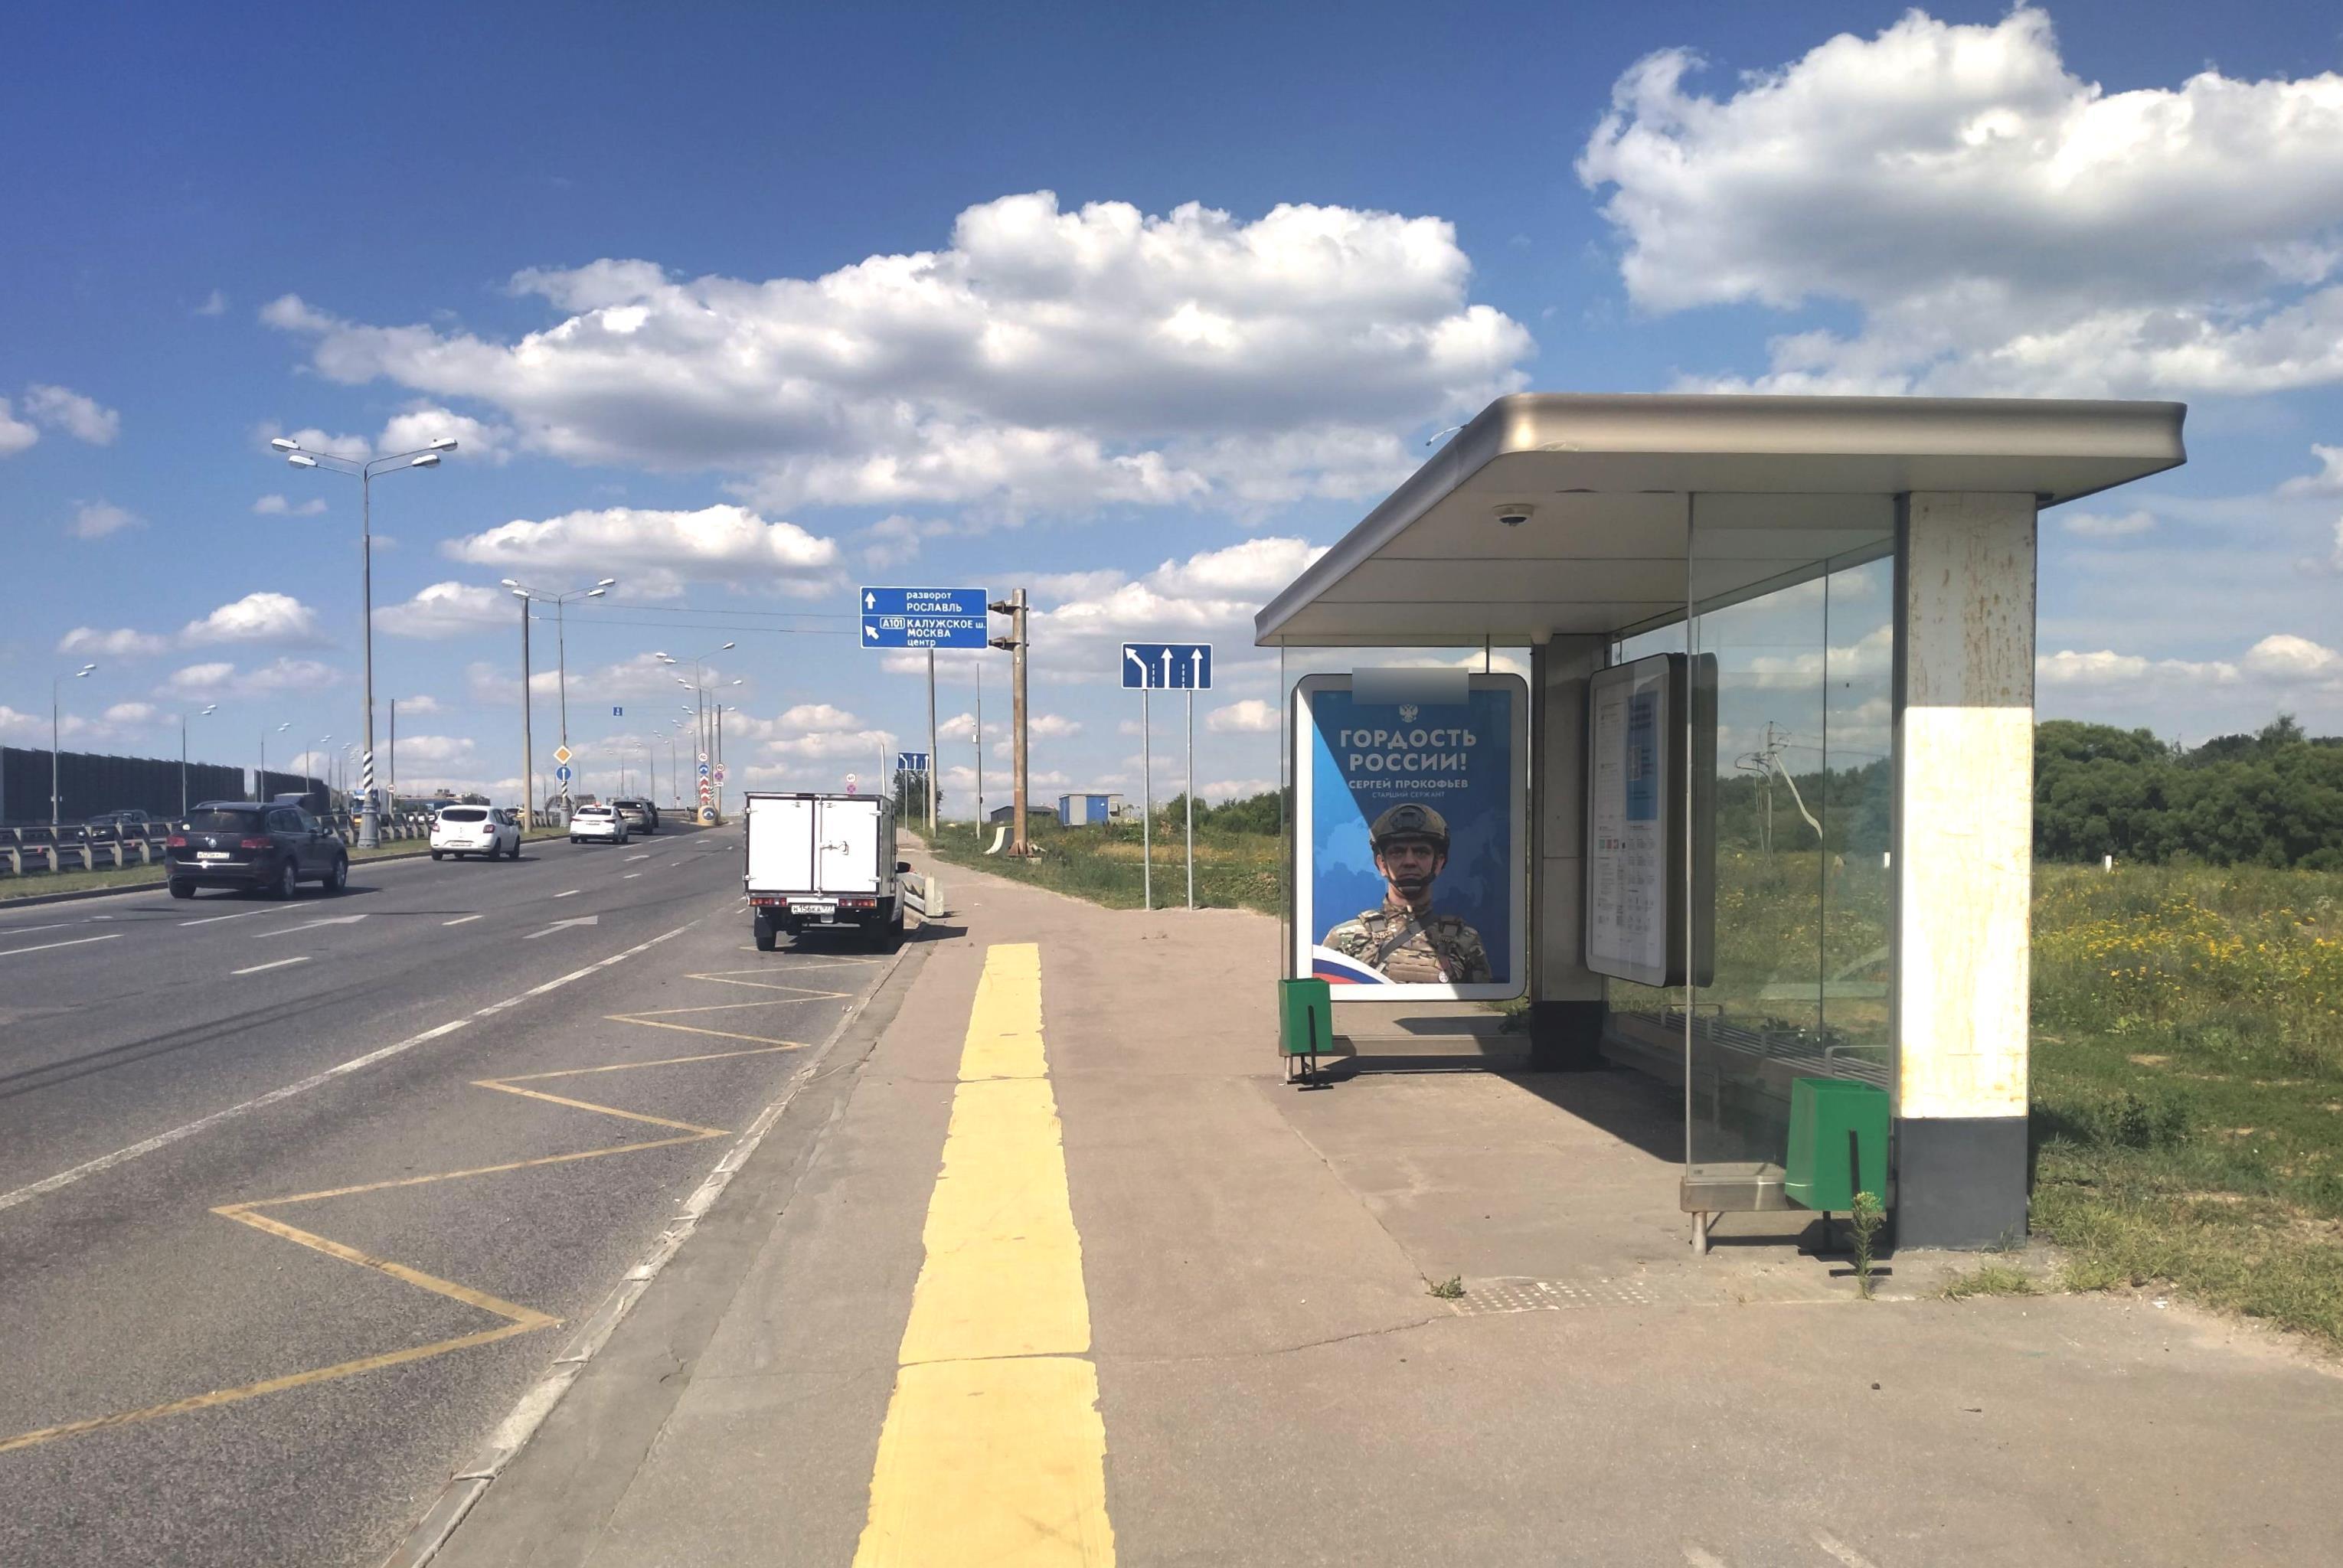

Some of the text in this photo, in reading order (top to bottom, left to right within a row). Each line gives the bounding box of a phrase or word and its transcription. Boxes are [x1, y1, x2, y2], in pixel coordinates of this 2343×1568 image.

[907, 592, 952, 600] разворот
[907, 603, 962, 612] РОСЛАВЛЬ
[907, 619, 973, 629] КАЛУЖСКОЕ
[907, 629, 951, 638] МОСКВА
[907, 639, 936, 648] центр
[1341, 729, 1476, 750] ГОРДОСТЬ
[1349, 753, 1467, 772] РОССИИ!
[1348, 778, 1469, 789] СЕРГЕЙ ПРОКОФЬЕВ
